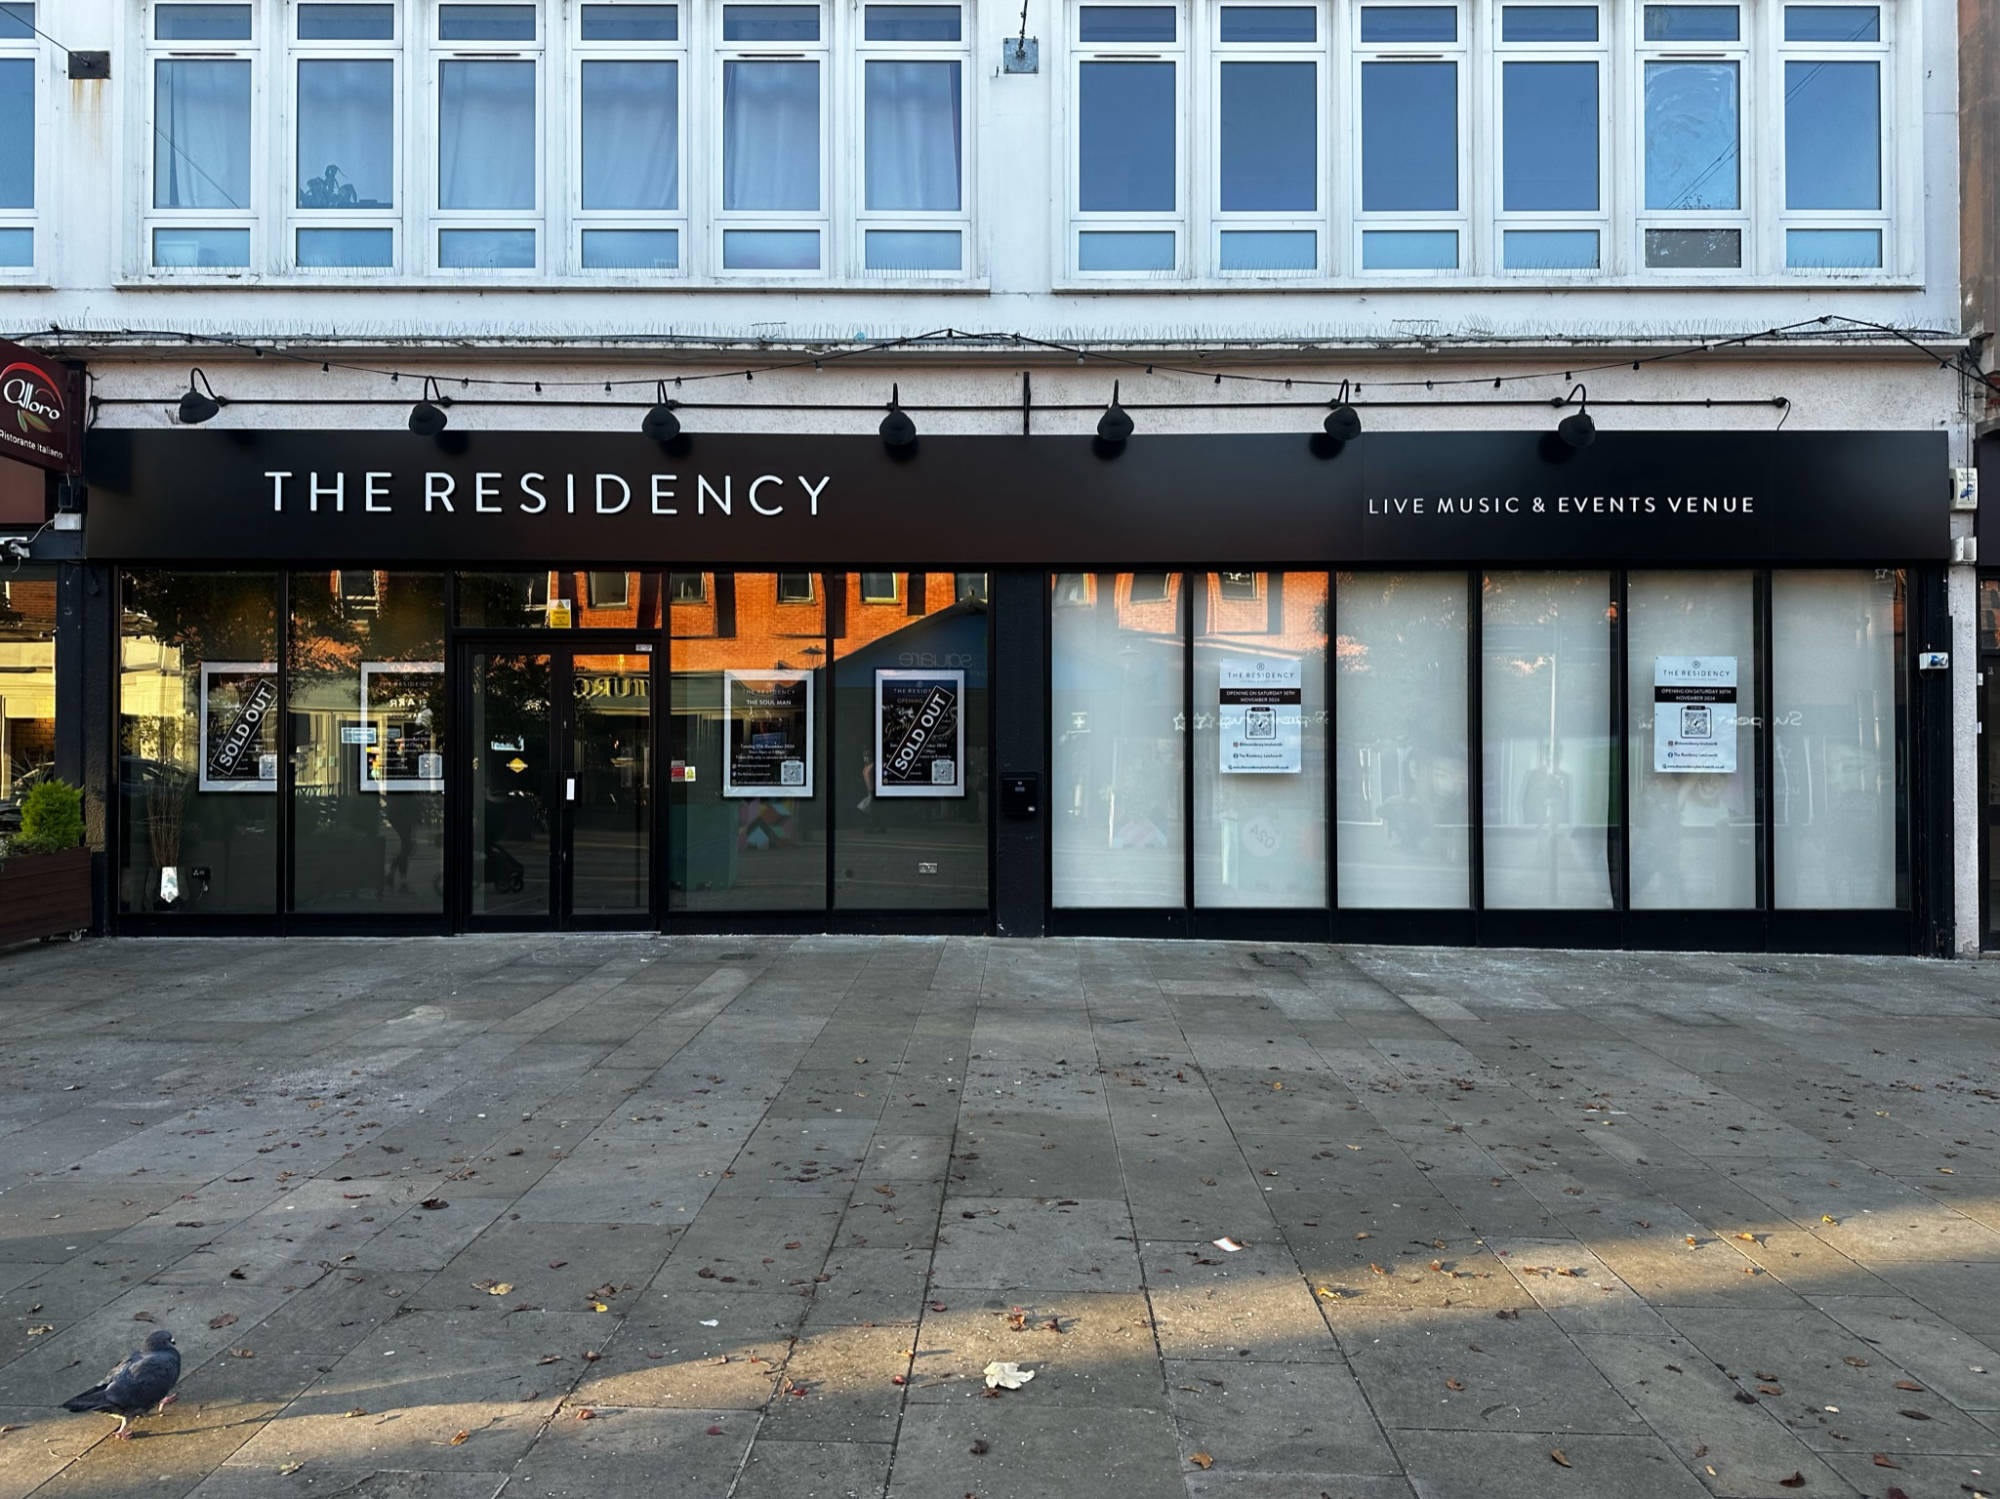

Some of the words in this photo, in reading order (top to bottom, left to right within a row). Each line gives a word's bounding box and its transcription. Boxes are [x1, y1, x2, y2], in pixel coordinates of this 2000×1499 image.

[264, 471, 392, 512] THE
[425, 472, 830, 516] RESIDENCY
[1369, 498, 1424, 514] LIVE
[1437, 497, 1519, 514] MUSIC
[1532, 496, 1546, 513] &
[1558, 496, 1656, 513] EVENTS
[1667, 496, 1754, 513] VENUE
[1227, 671, 1242, 679] THE
[1246, 671, 1294, 679] RESIDENCY
[1663, 669, 1679, 677] THE
[1681, 669, 1730, 677] RESIDENCY
[219, 723, 250, 767] SOLD
[245, 687, 272, 722] OUT
[894, 728, 926, 771] SOLD
[920, 693, 946, 728] OUT
